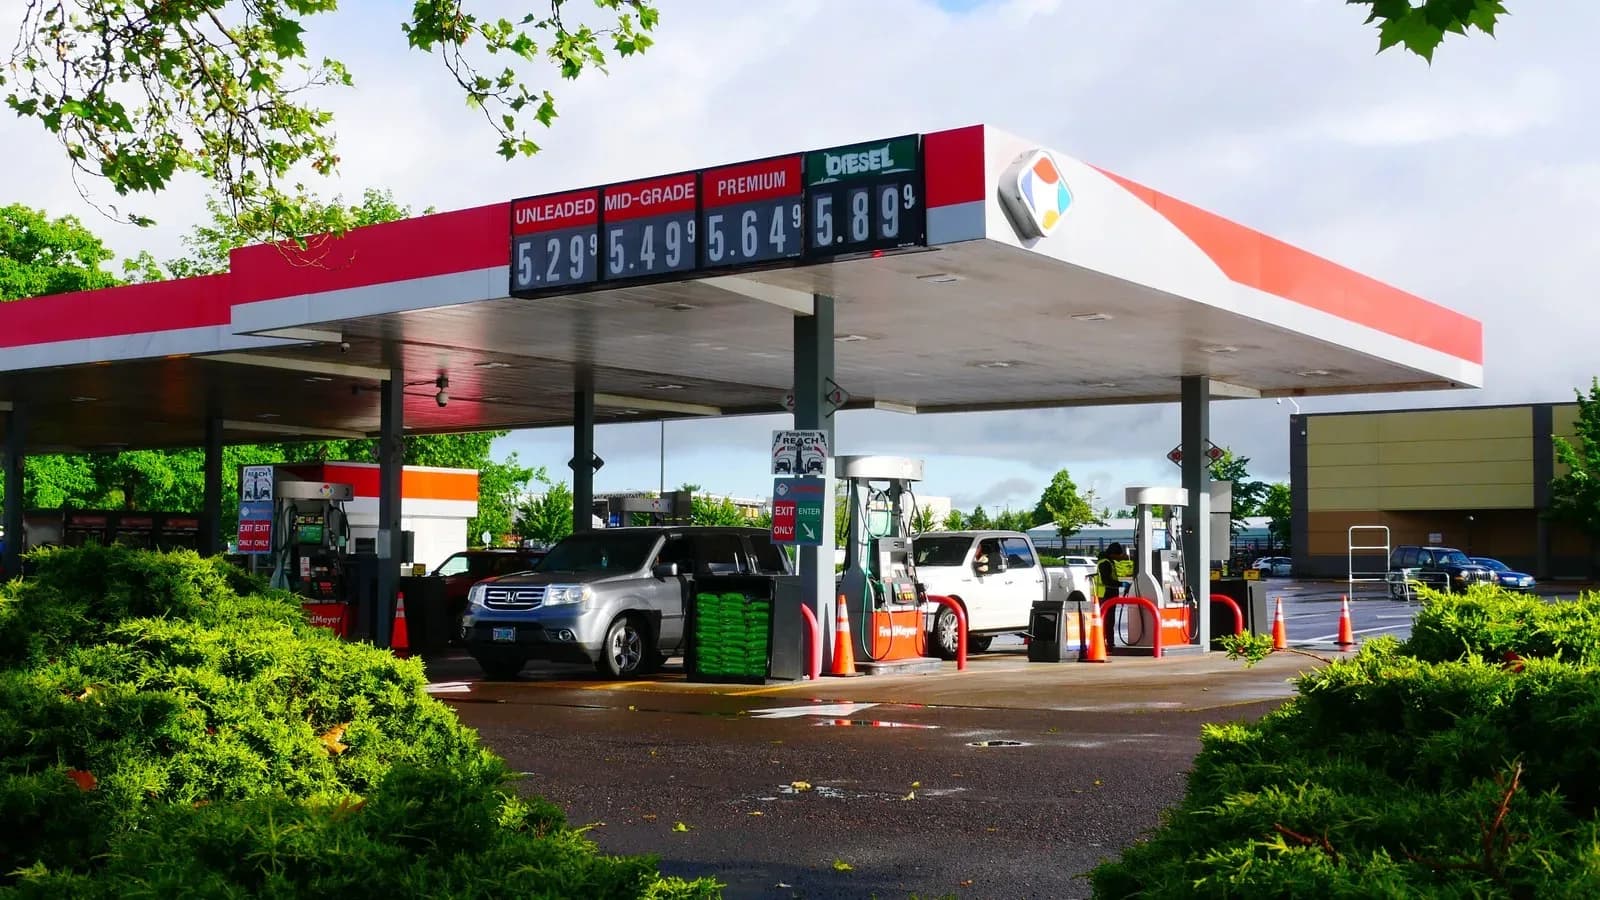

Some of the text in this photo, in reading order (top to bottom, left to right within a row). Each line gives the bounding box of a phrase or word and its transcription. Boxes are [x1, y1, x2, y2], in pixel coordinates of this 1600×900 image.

[824, 143, 894, 176] DIESEL
[717, 170, 786, 197] PREMIUM
[604, 182, 695, 212] MID-GRADE
[516, 198, 596, 225] UNLEADED
[783, 437, 819, 447] REACH
[775, 506, 795, 516] EXIT
[798, 507, 821, 516] ENTER
[239, 524, 253, 532] EXIT
[255, 524, 270, 532] EXIT
[773, 525, 794, 535] ONLY
